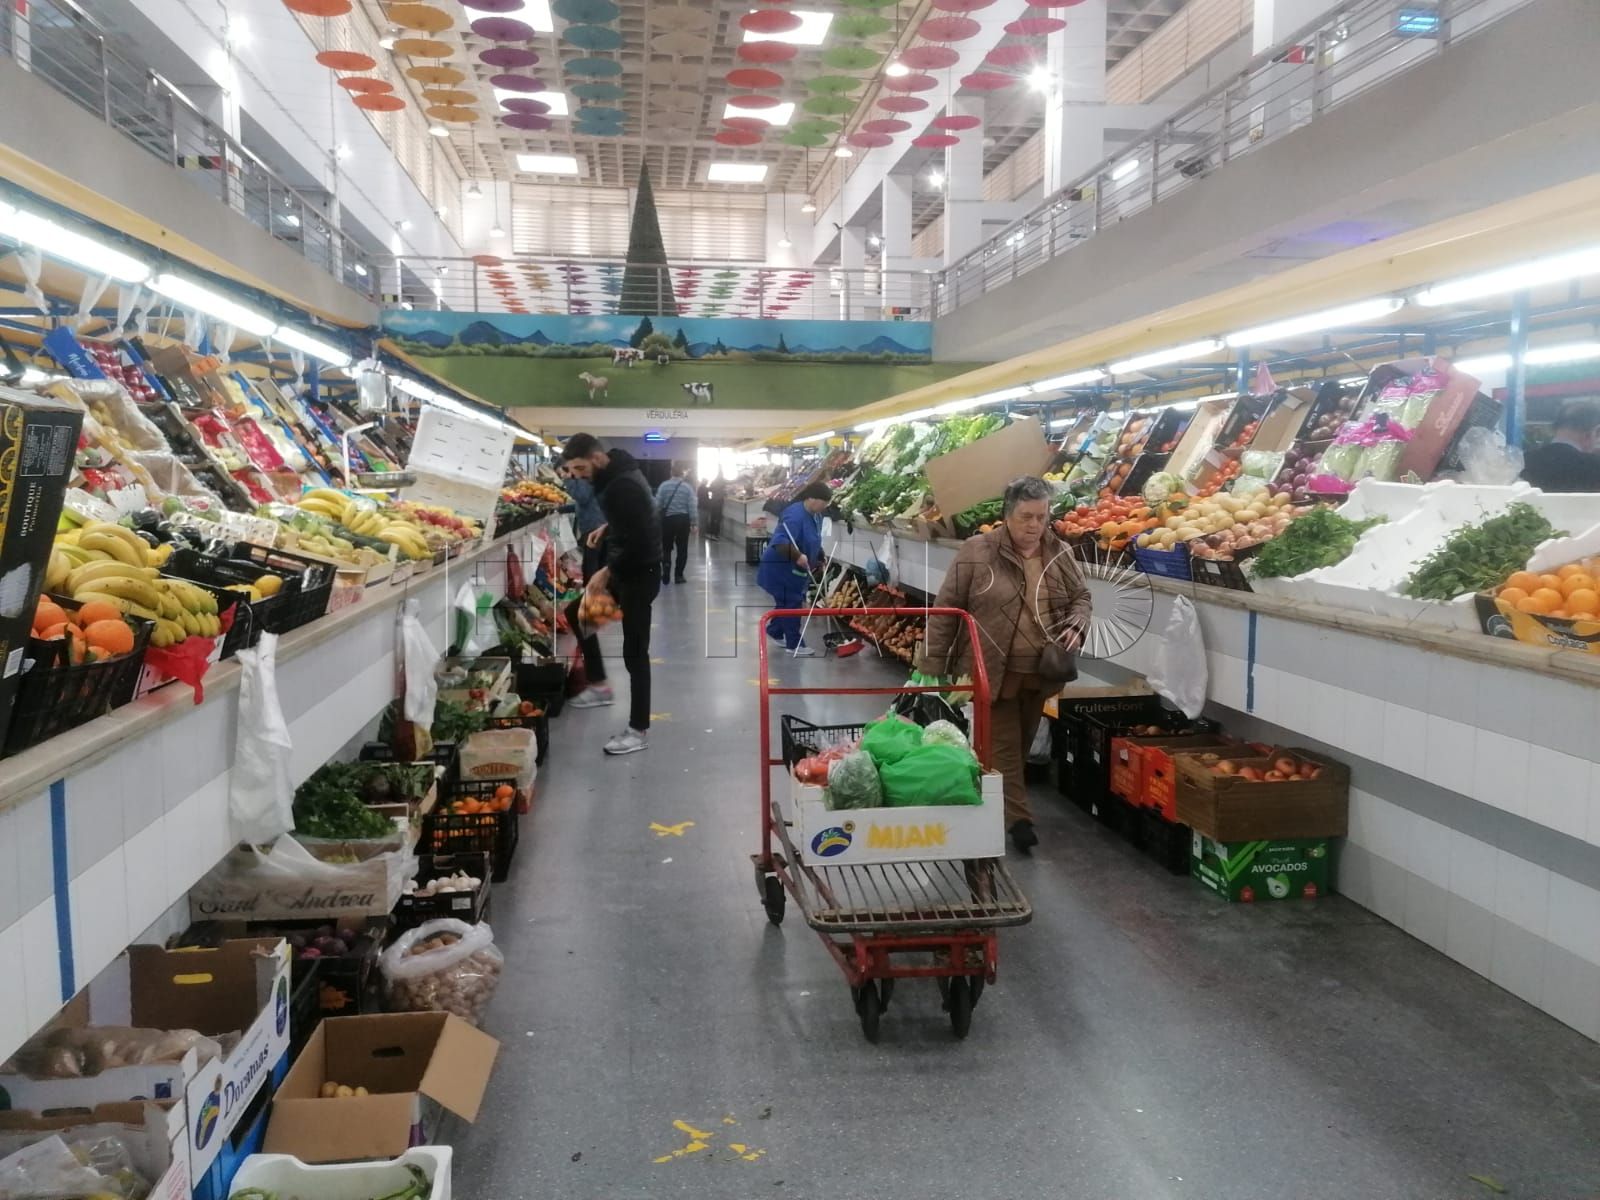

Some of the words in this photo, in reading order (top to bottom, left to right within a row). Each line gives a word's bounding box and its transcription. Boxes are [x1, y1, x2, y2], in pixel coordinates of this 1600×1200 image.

[19, 480, 37, 537] BOUTIQUE
[866, 822, 946, 849] MIAN
[1251, 862, 1308, 873] AVOCADOS
